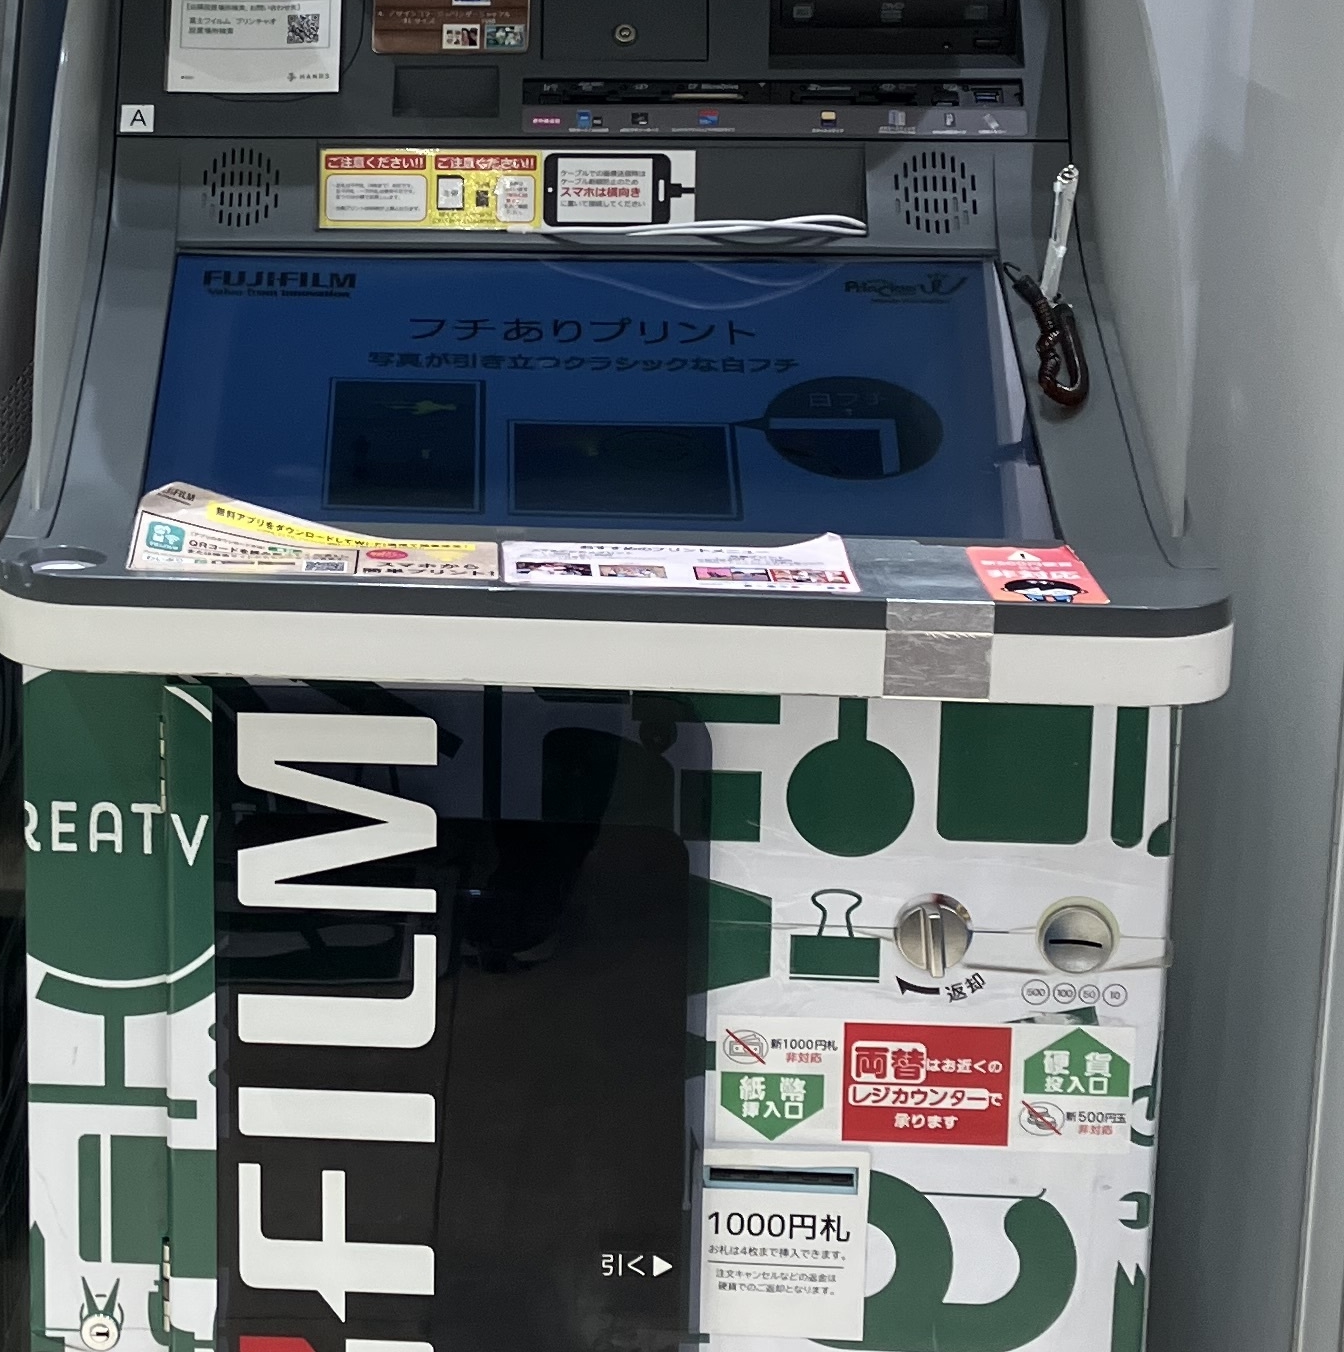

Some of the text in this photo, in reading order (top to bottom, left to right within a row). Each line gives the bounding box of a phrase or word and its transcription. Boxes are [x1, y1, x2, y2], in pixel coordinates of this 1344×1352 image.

[129, 109, 147, 127] A
[560, 186, 641, 198] スマホは横向き
[203, 270, 357, 289] FUJIFILM
[407, 315, 759, 347] フチありプリント
[366, 348, 800, 377] 写真が引き立つクラシックな白フチ
[945, 972, 987, 1004] 返却
[1026, 987, 1046, 998] 500
[1056, 988, 1074, 999] 100
[771, 1037, 838, 1052] 新1000円札
[785, 1052, 822, 1064] 非対応
[852, 1045, 1003, 1082] 両替はお近くの
[1042, 1049, 1112, 1078] 硬貨
[739, 1076, 807, 1102] 紙幣
[1044, 1076, 1108, 1095] 投入口
[851, 1086, 1003, 1109] レジカウンターで
[893, 1112, 959, 1131] 承ります
[1065, 1110, 1126, 1125] 新500円玉
[1077, 1124, 1113, 1136] 非対応
[708, 1210, 852, 1243] 1000円札
[708, 1244, 847, 1262] お札は4枚まで挿入できます。
[601, 1254, 645, 1278] 引く
